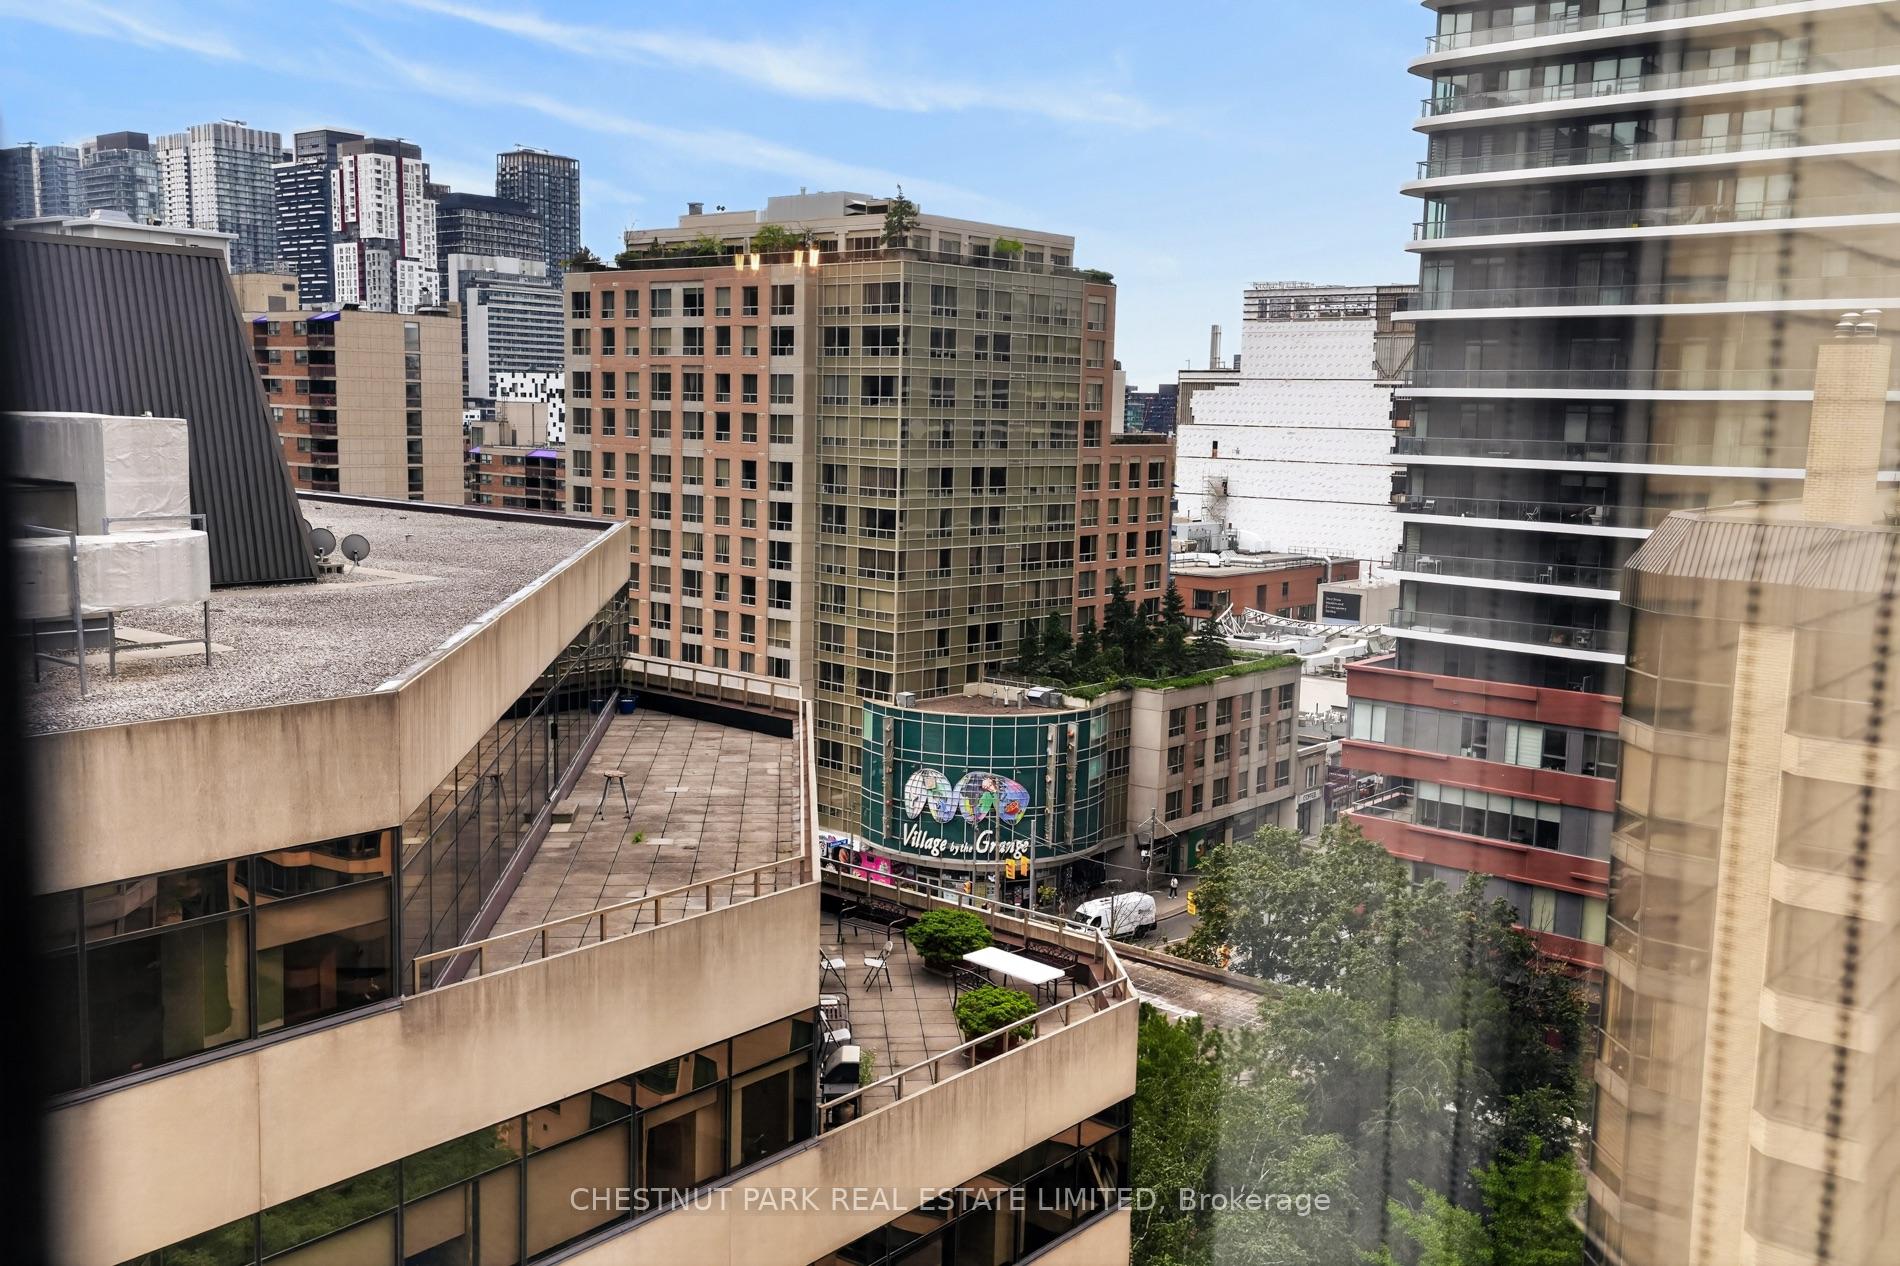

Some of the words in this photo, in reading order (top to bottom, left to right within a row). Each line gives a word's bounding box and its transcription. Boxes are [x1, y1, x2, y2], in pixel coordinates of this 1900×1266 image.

[903, 823, 947, 856] Village
[950, 842, 960, 855] by
[960, 843, 973, 853] the
[975, 829, 1030, 859] Grange
